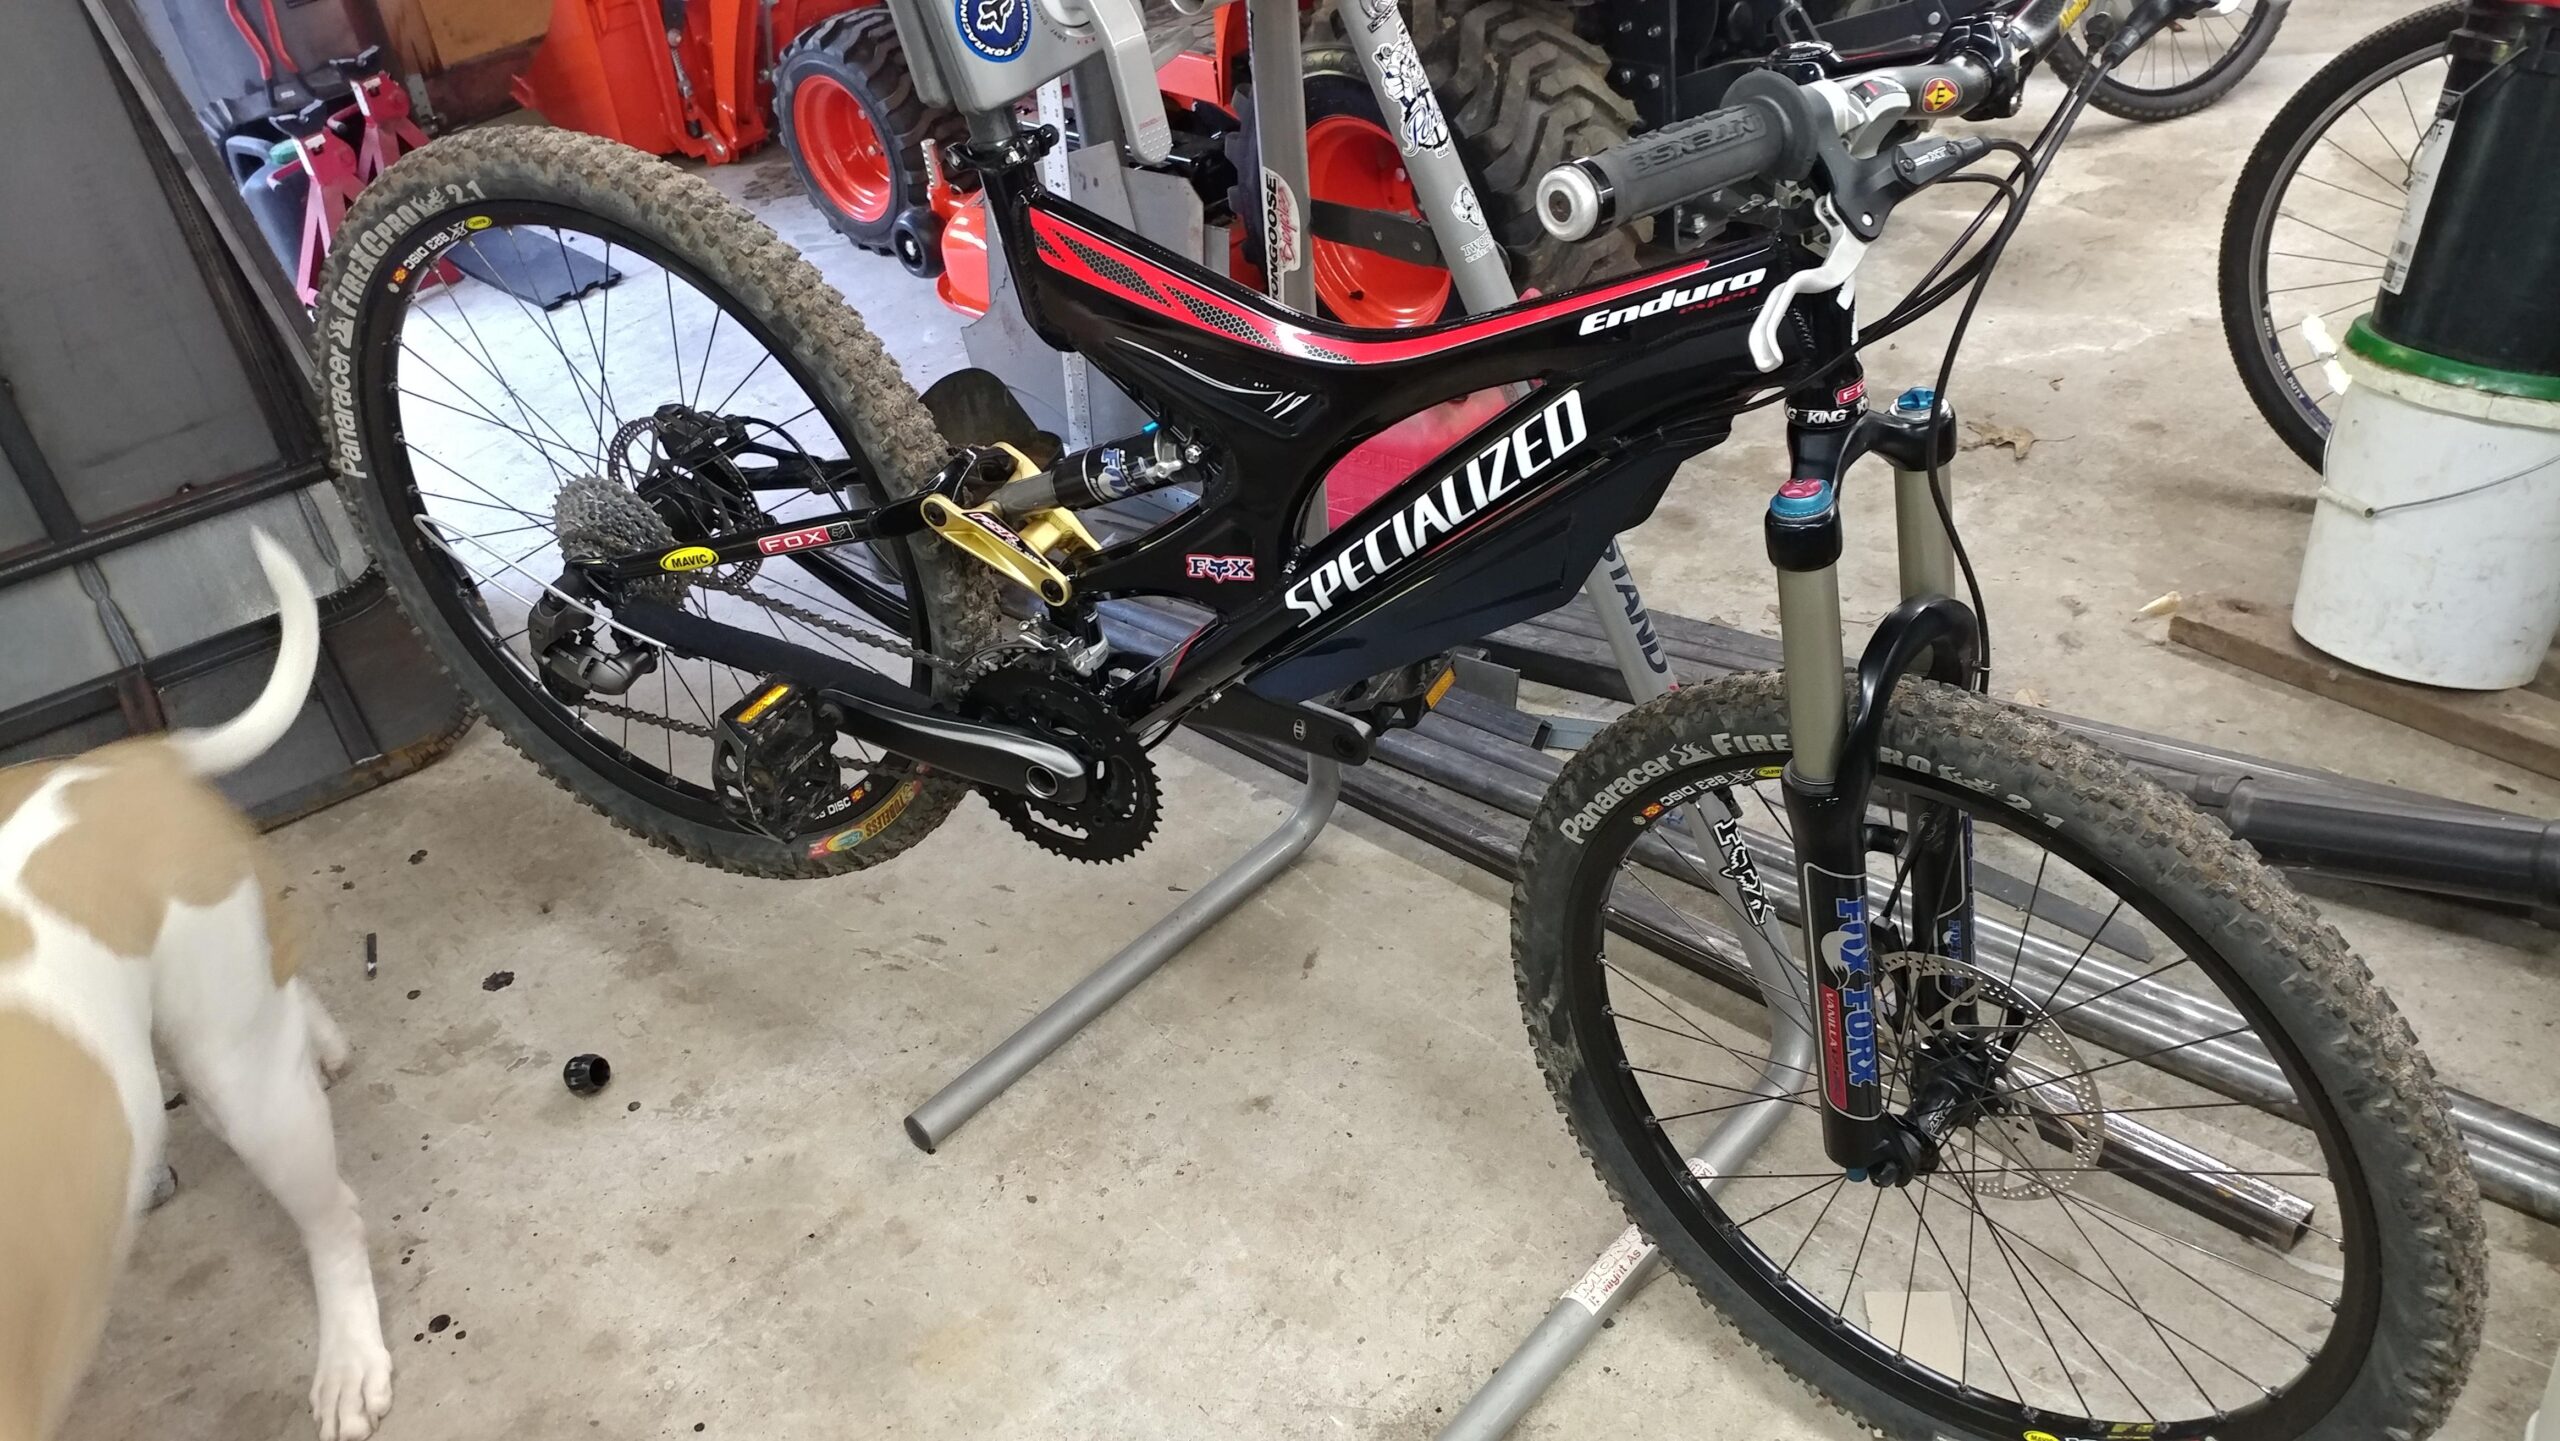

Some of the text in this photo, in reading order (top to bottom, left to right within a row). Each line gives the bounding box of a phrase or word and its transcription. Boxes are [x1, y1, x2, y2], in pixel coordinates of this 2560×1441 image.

[445, 179, 487, 203] 2.1
[425, 231, 450, 251] 823
[1266, 174, 1279, 300] ONGOOSE
[402, 246, 430, 271] DISC
[1578, 267, 1767, 336] Enduro
[1679, 287, 1758, 315] expert
[2274, 352, 2305, 399] DUAL DUTY
[1842, 380, 1866, 400] FO
[328, 344, 368, 479] Panaracer
[1806, 409, 1848, 424] KING
[1284, 388, 1588, 628] SPECIALIZED
[764, 531, 825, 552] FOX
[671, 553, 709, 569] MAVIC
[1694, 775, 1729, 791] 823
[827, 796, 852, 816] DISC
[1559, 754, 1675, 845] Panaracer
[1659, 785, 1697, 807] DISC
[864, 796, 907, 838] TUBELESS
[1825, 992, 1839, 1047] VANILLA
[1842, 981, 1878, 1088] FORX
[1627, 1249, 1642, 1266] As
